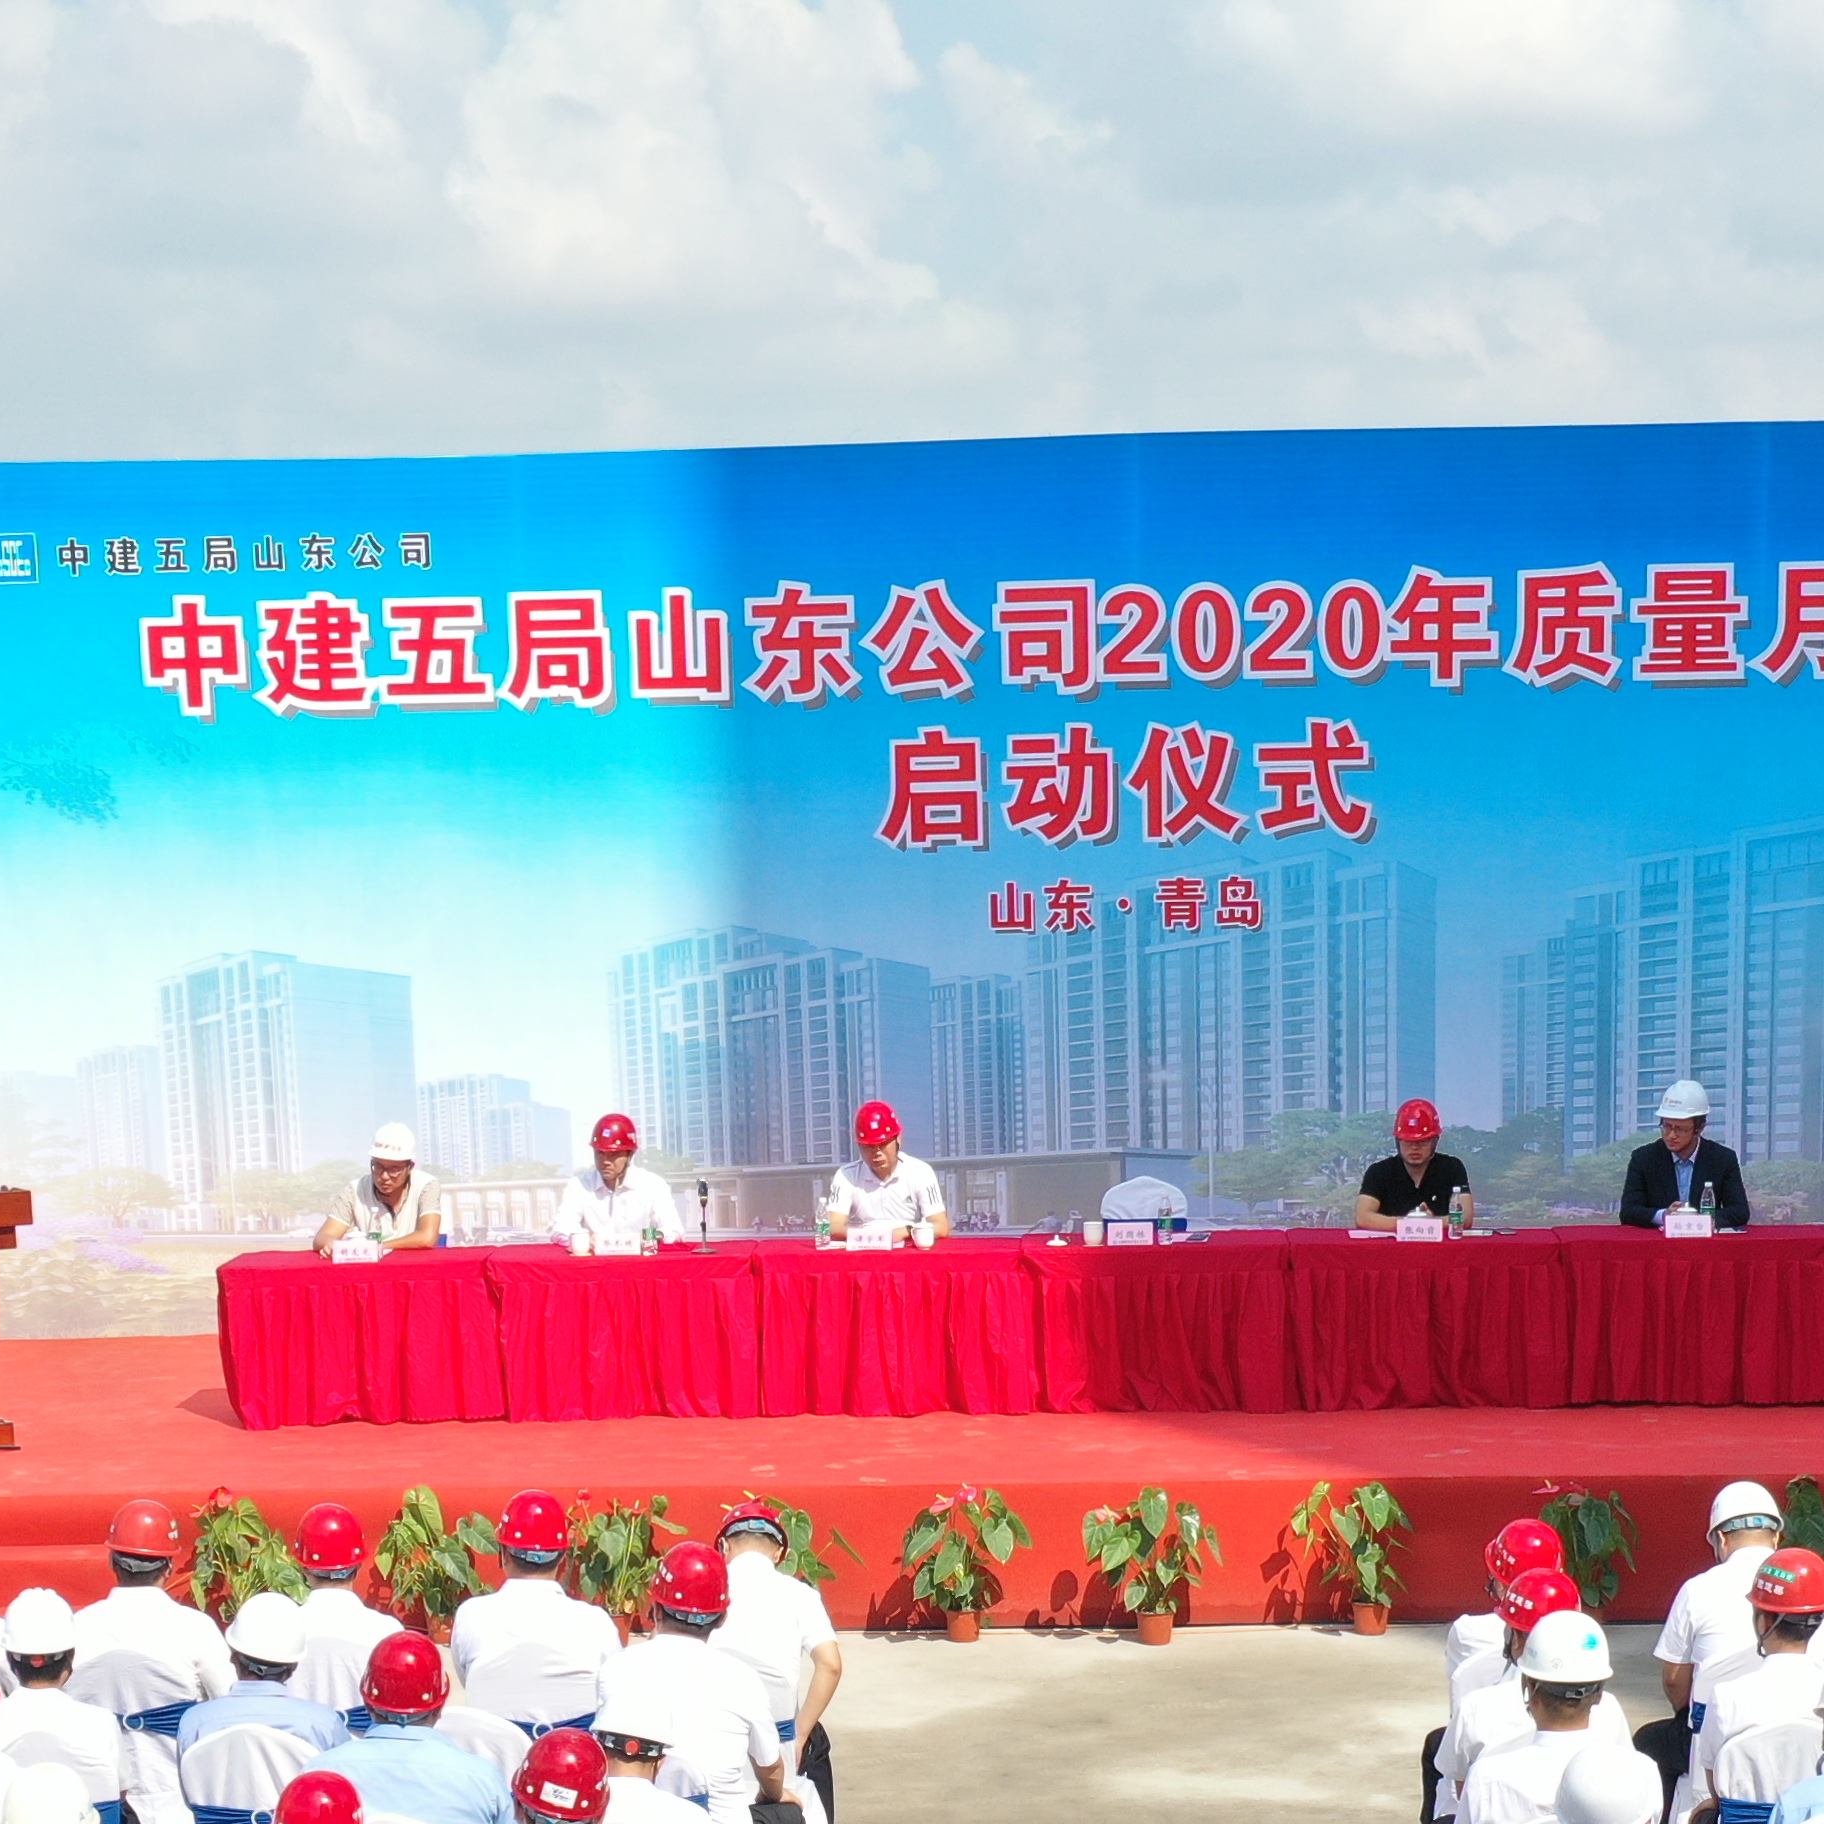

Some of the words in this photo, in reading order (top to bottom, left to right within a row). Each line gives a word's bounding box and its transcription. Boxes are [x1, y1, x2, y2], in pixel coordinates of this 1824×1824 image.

[56, 532, 432, 577] 中建五局山东公司
[879, 719, 1372, 849] 启动仪式
